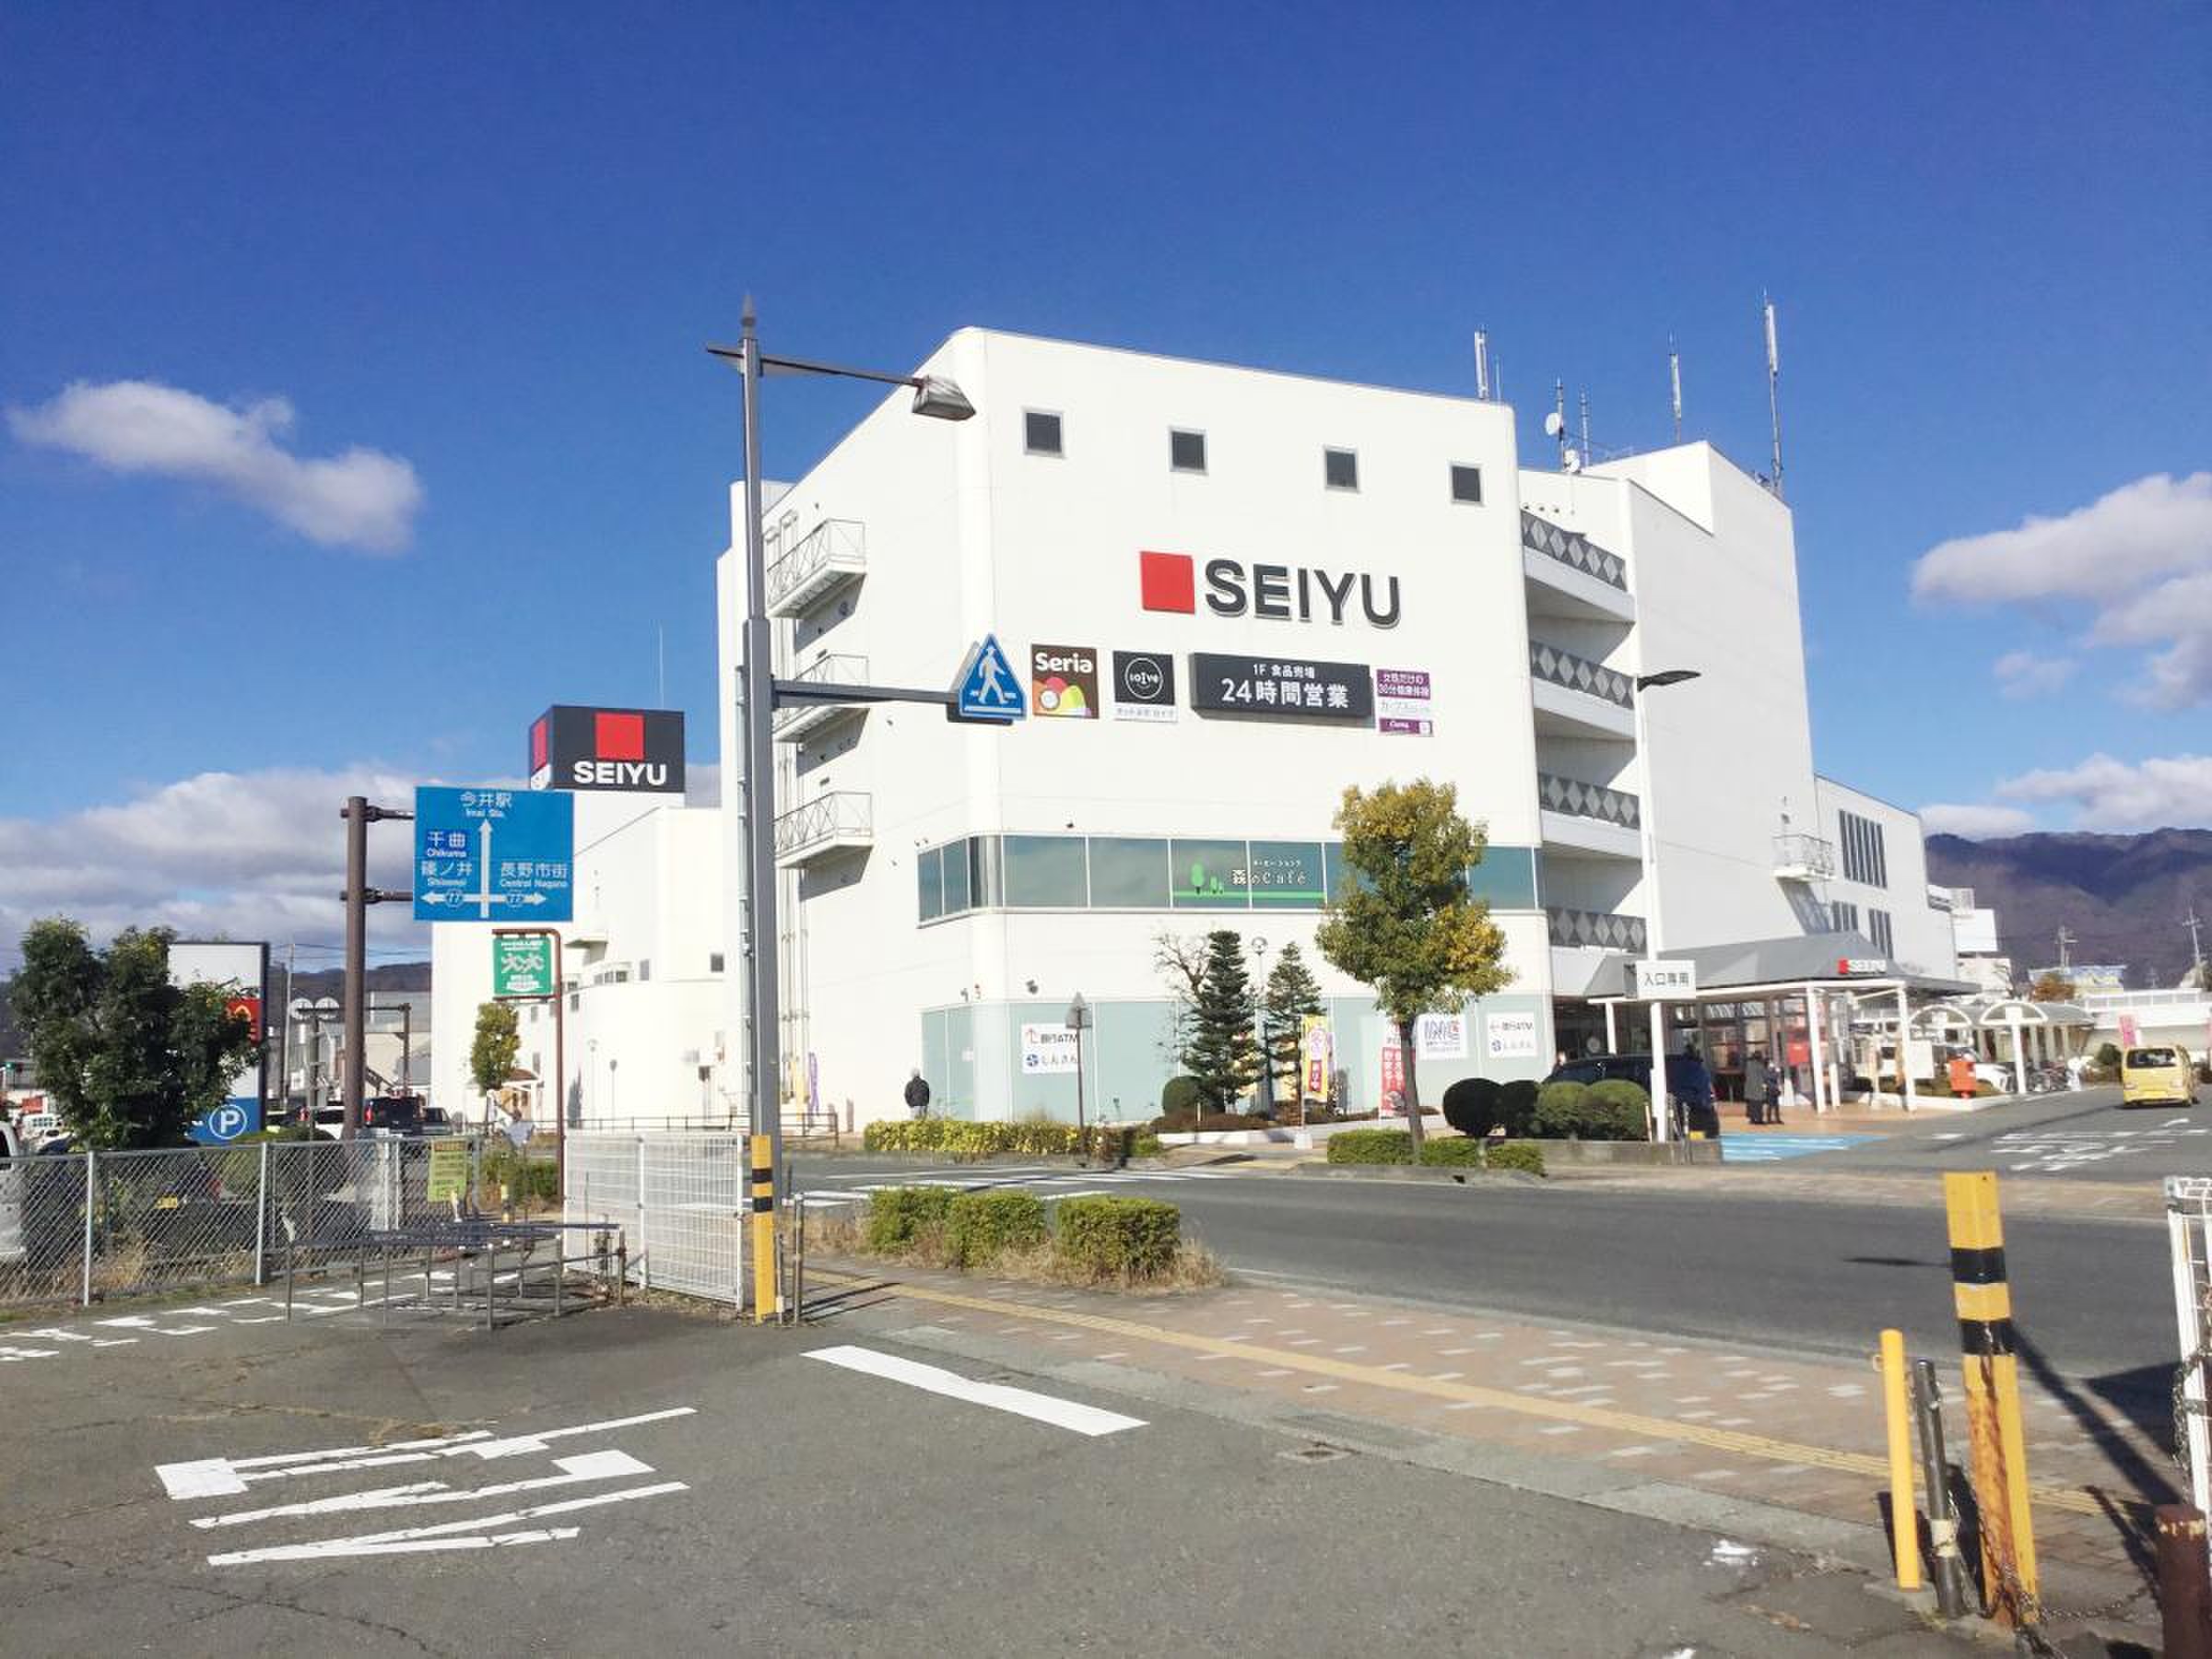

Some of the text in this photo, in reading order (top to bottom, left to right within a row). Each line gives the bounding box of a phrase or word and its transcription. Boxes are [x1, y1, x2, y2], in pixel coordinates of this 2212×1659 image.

[1205, 558, 1402, 629] SEIYU
[1035, 653, 1093, 674] Seria
[1253, 664, 1267, 676] 1F
[1221, 678, 1349, 709] 24時間営業
[573, 760, 667, 785] SEIYU
[1644, 972, 1689, 987] 入口専用
[220, 1110, 241, 1134] P
